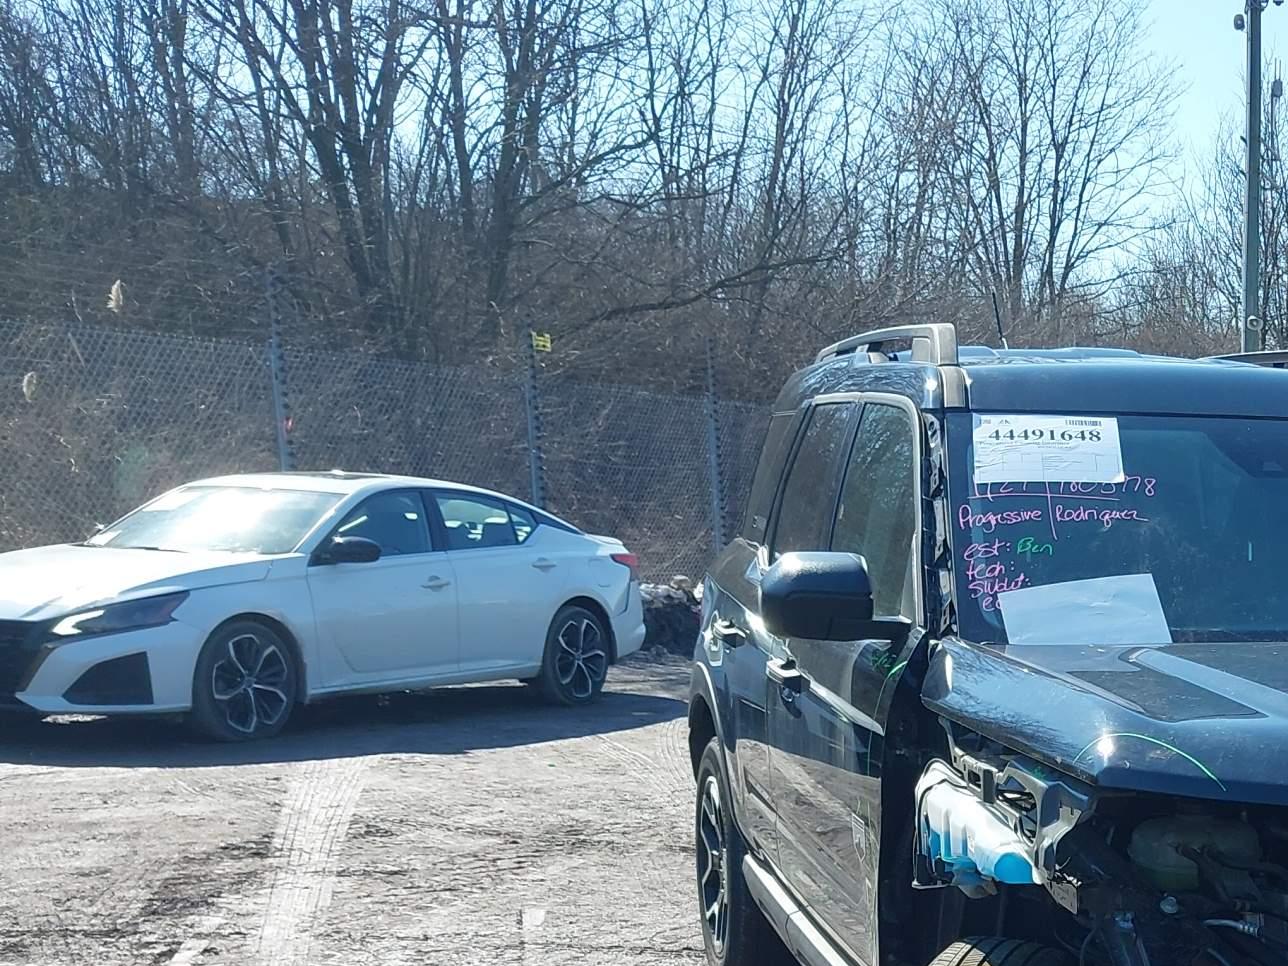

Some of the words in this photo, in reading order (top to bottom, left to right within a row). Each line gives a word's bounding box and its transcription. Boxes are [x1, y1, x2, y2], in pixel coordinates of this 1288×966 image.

[988, 428, 1102, 442] 44491648
[959, 504, 1043, 533] Progressive
[1016, 536, 1053, 556] Ben
